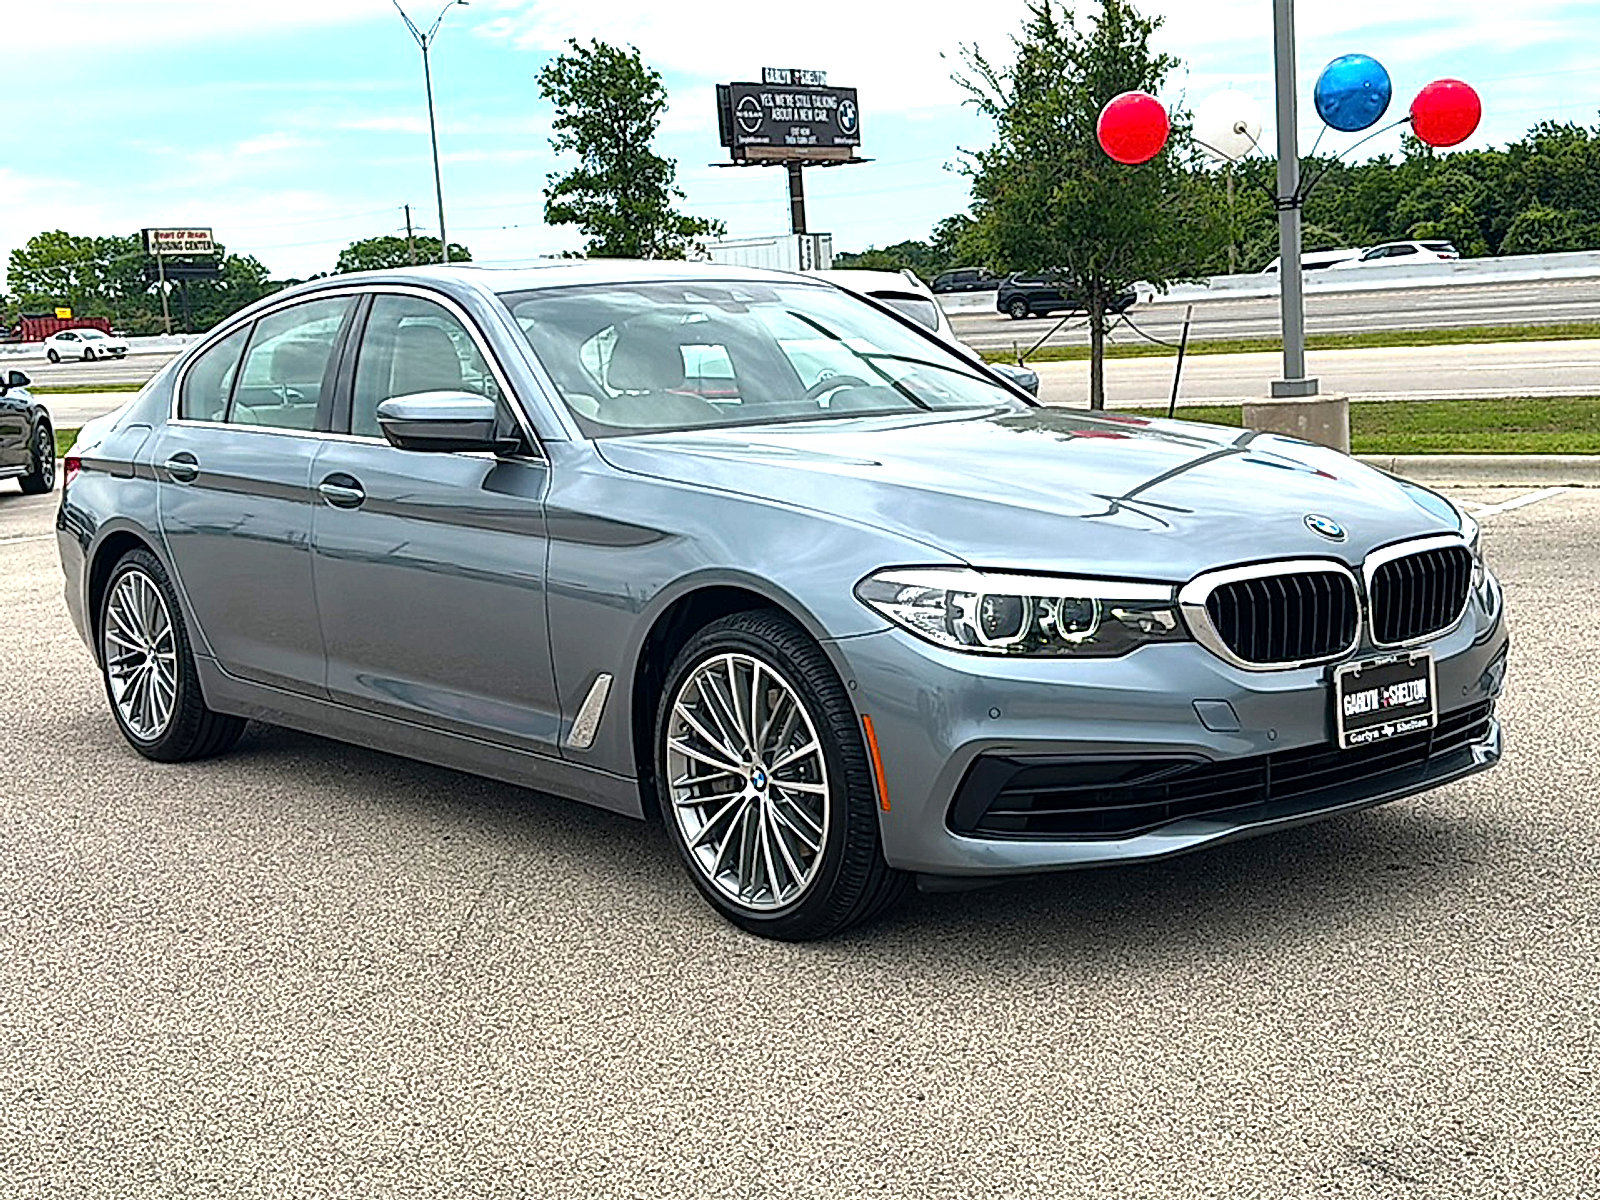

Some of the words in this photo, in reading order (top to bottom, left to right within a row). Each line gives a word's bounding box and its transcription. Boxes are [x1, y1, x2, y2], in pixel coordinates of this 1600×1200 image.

[795, 95, 811, 108] STILL
[812, 95, 838, 109] TALKING
[772, 108, 792, 121] ABOUT
[793, 109, 799, 121] A
[800, 109, 812, 121] NEW
[185, 241, 211, 250] CENTER
[1343, 688, 1379, 716] GARLYN
[1388, 678, 1427, 706] SHELTON
[1350, 730, 1379, 743] Garlyn
[1396, 719, 1428, 733] Shelton
